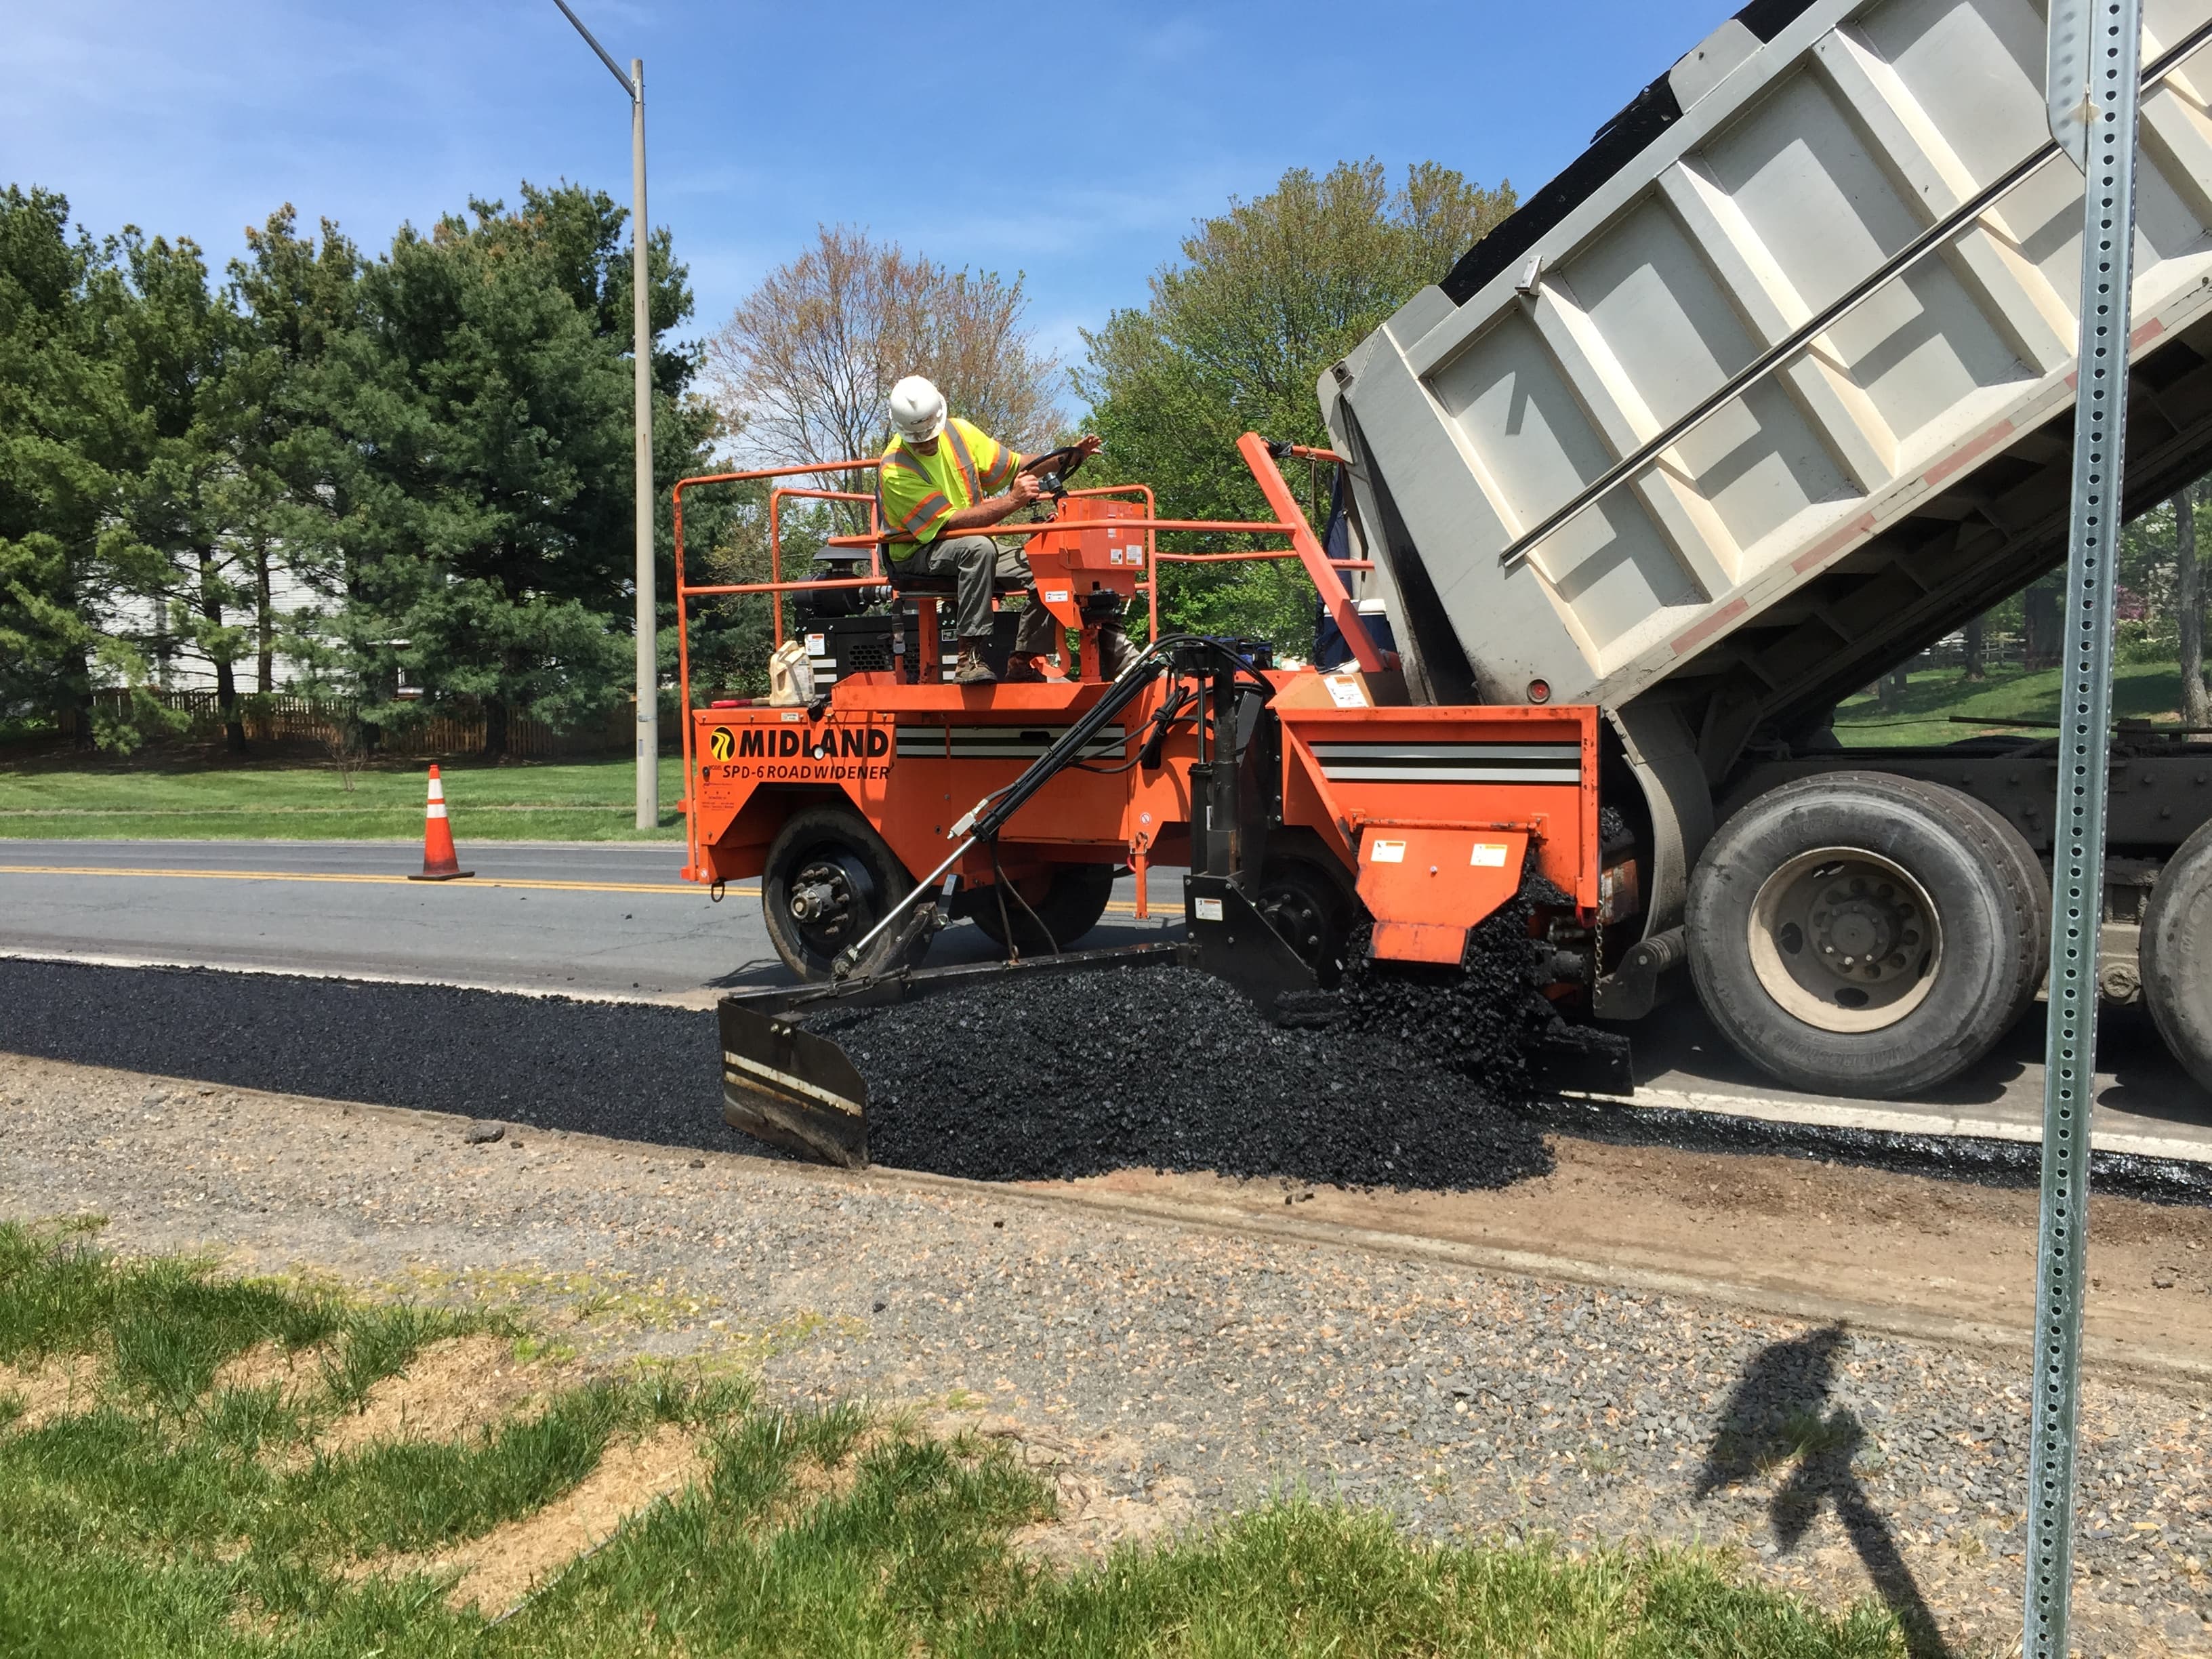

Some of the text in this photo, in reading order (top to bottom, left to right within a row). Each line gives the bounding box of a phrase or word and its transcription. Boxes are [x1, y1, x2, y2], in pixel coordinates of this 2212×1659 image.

[739, 729, 889, 758] MIDLAND
[722, 765, 764, 779] SPD-6
[767, 765, 811, 779] ROAD
[815, 766, 889, 779] WIDENER
